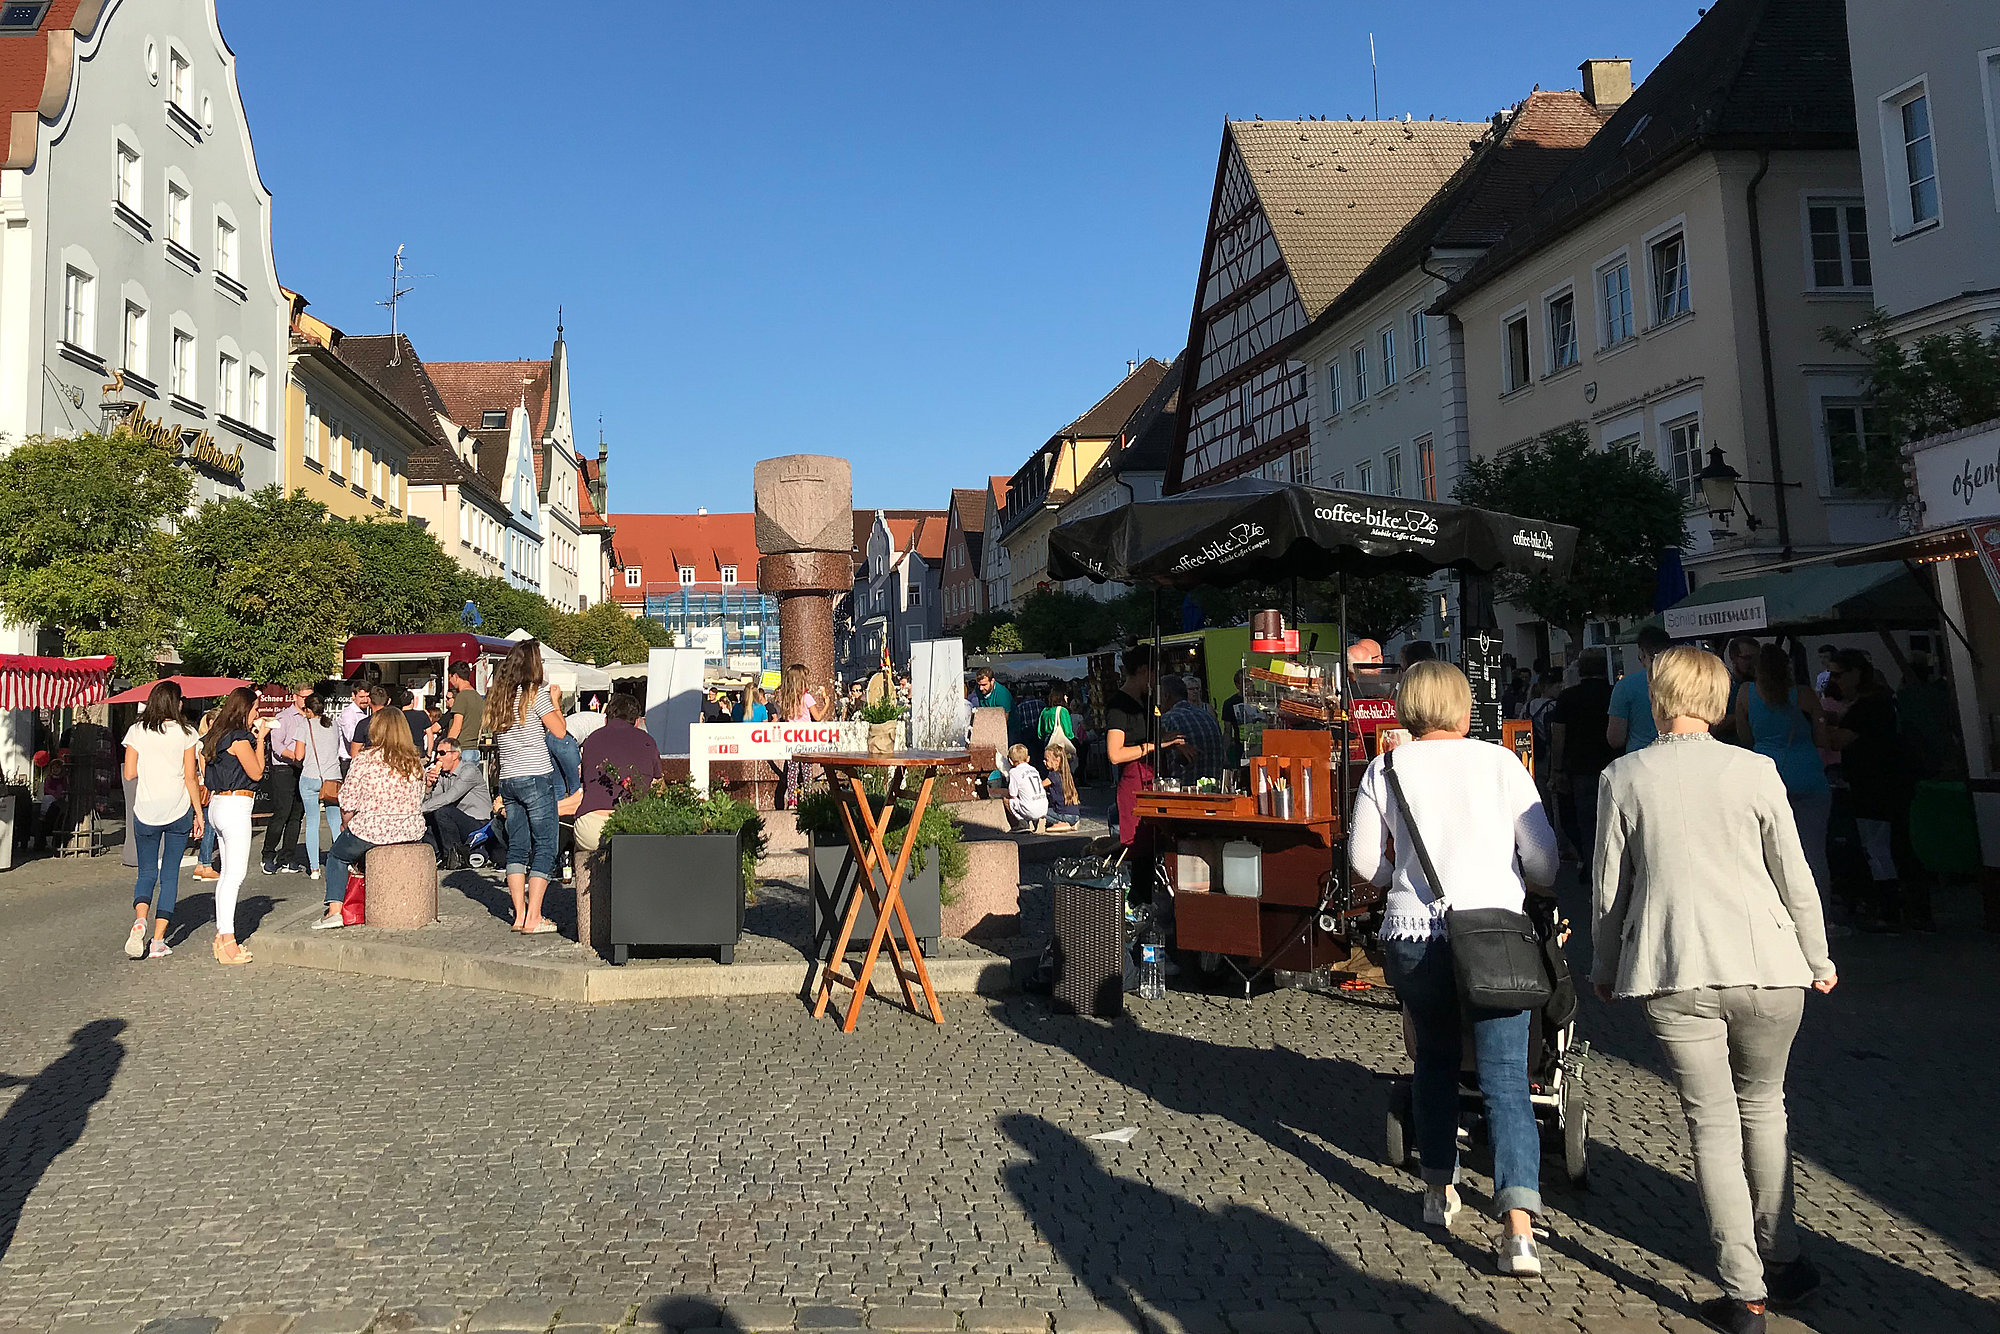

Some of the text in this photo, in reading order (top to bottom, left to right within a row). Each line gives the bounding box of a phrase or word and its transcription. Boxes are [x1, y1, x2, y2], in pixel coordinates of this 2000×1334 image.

[132, 400, 183, 451] Hotel
[1952, 447, 2000, 505] ofen
[1314, 503, 1400, 529] coffee-bike
[1371, 528, 1436, 546] Mobile Coffee Company
[260, 694, 284, 703] Schnee
[751, 726, 840, 743] GLÜCKLICH
[1028, 775, 1042, 795] 17
